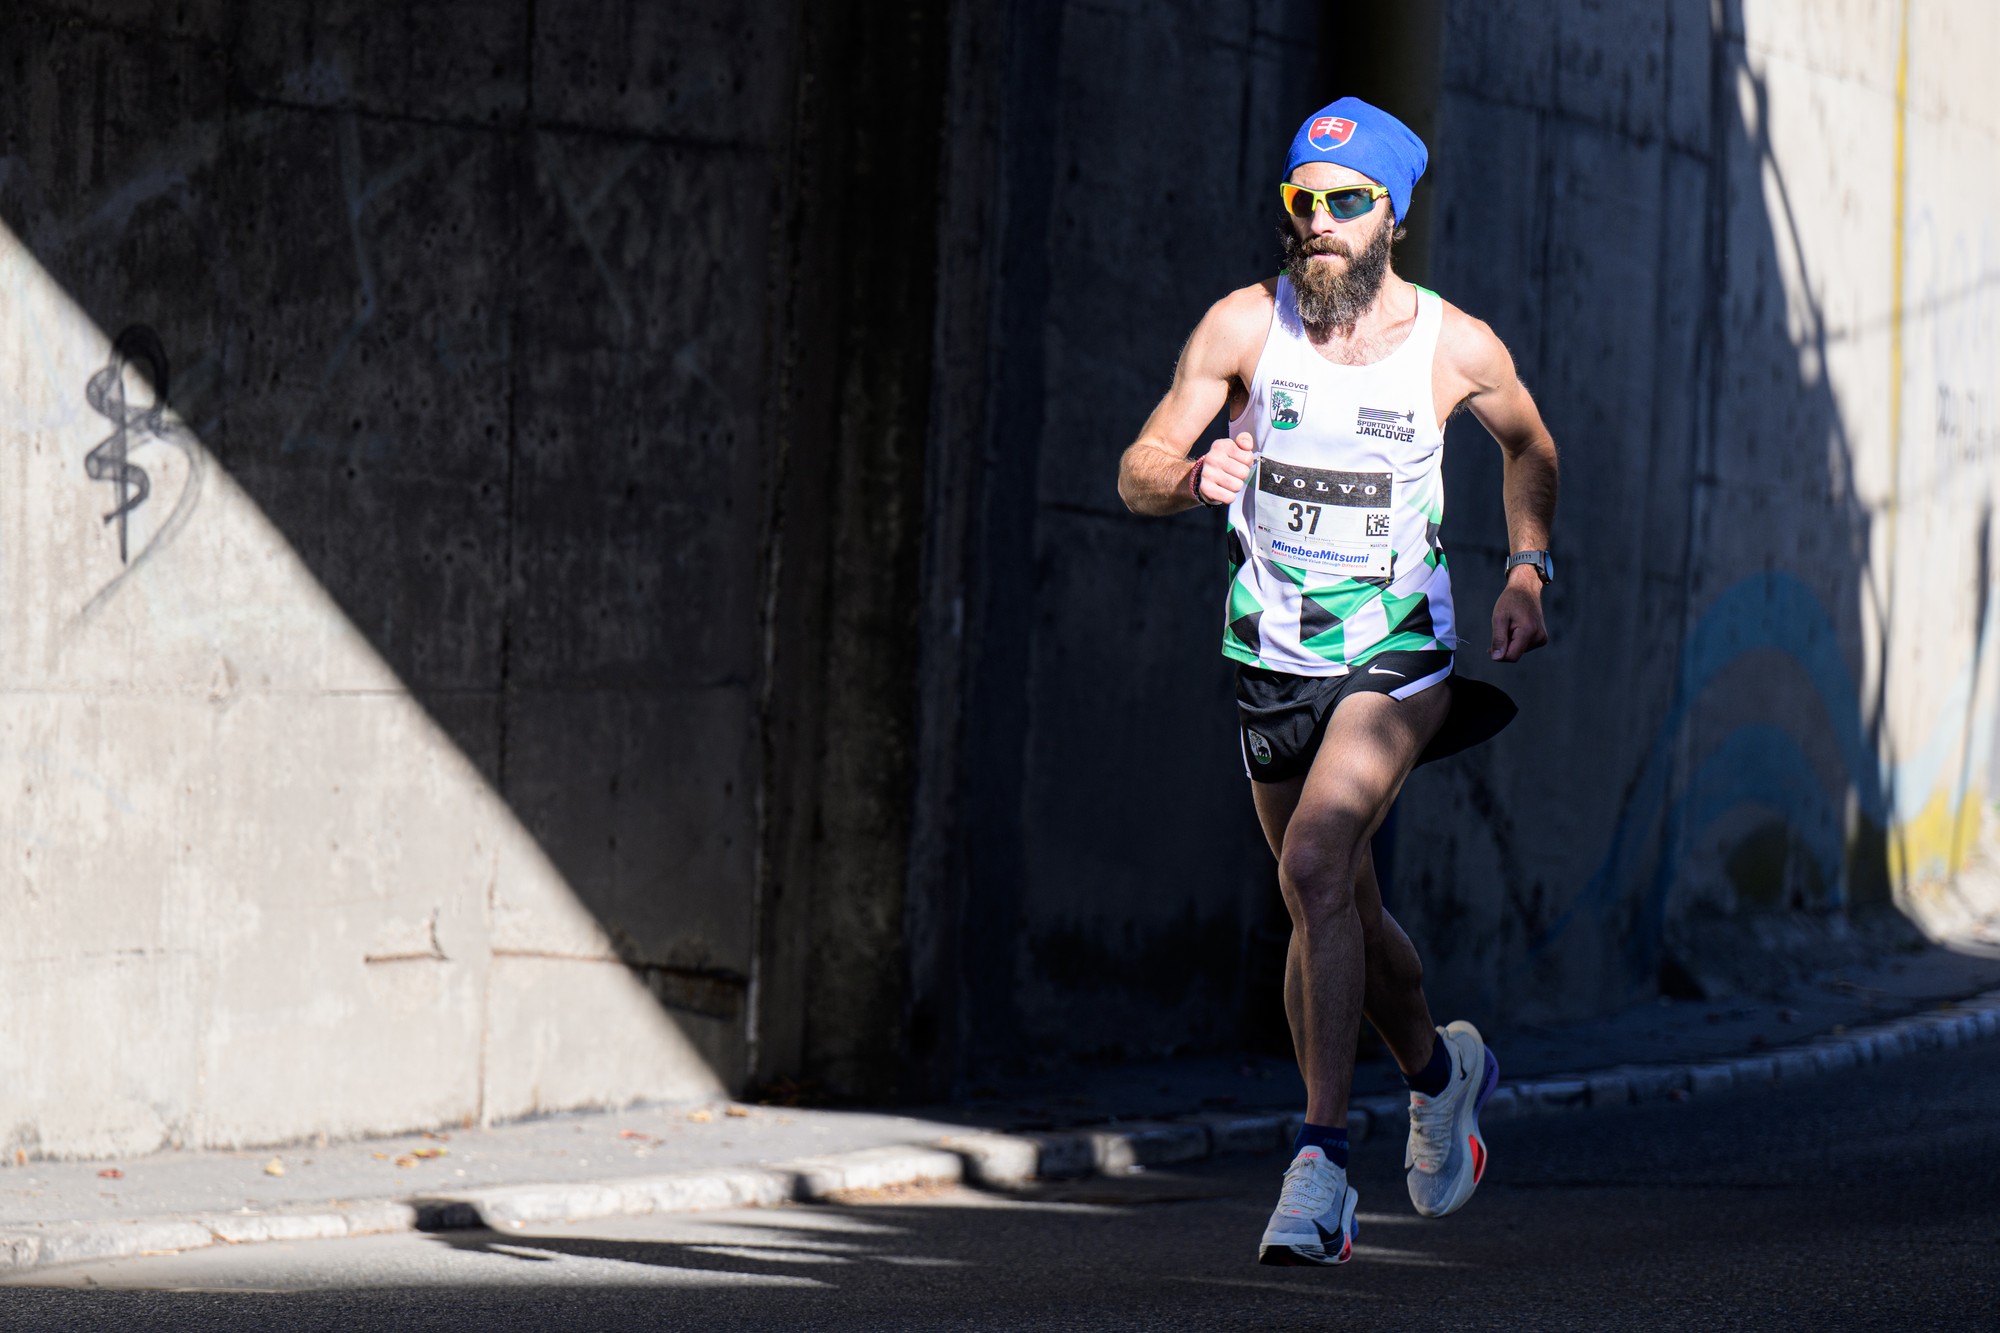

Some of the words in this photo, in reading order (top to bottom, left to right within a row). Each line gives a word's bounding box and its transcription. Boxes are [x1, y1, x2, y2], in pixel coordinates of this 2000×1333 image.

[1271, 379, 1309, 390] JAKLOVCE
[1356, 427, 1414, 443] JAKLOVCE
[1397, 426, 1415, 434] KLUB
[1271, 473, 1377, 495] VOLVO
[1287, 502, 1322, 535] 37
[1271, 539, 1370, 563] MinebeaMitsumi
